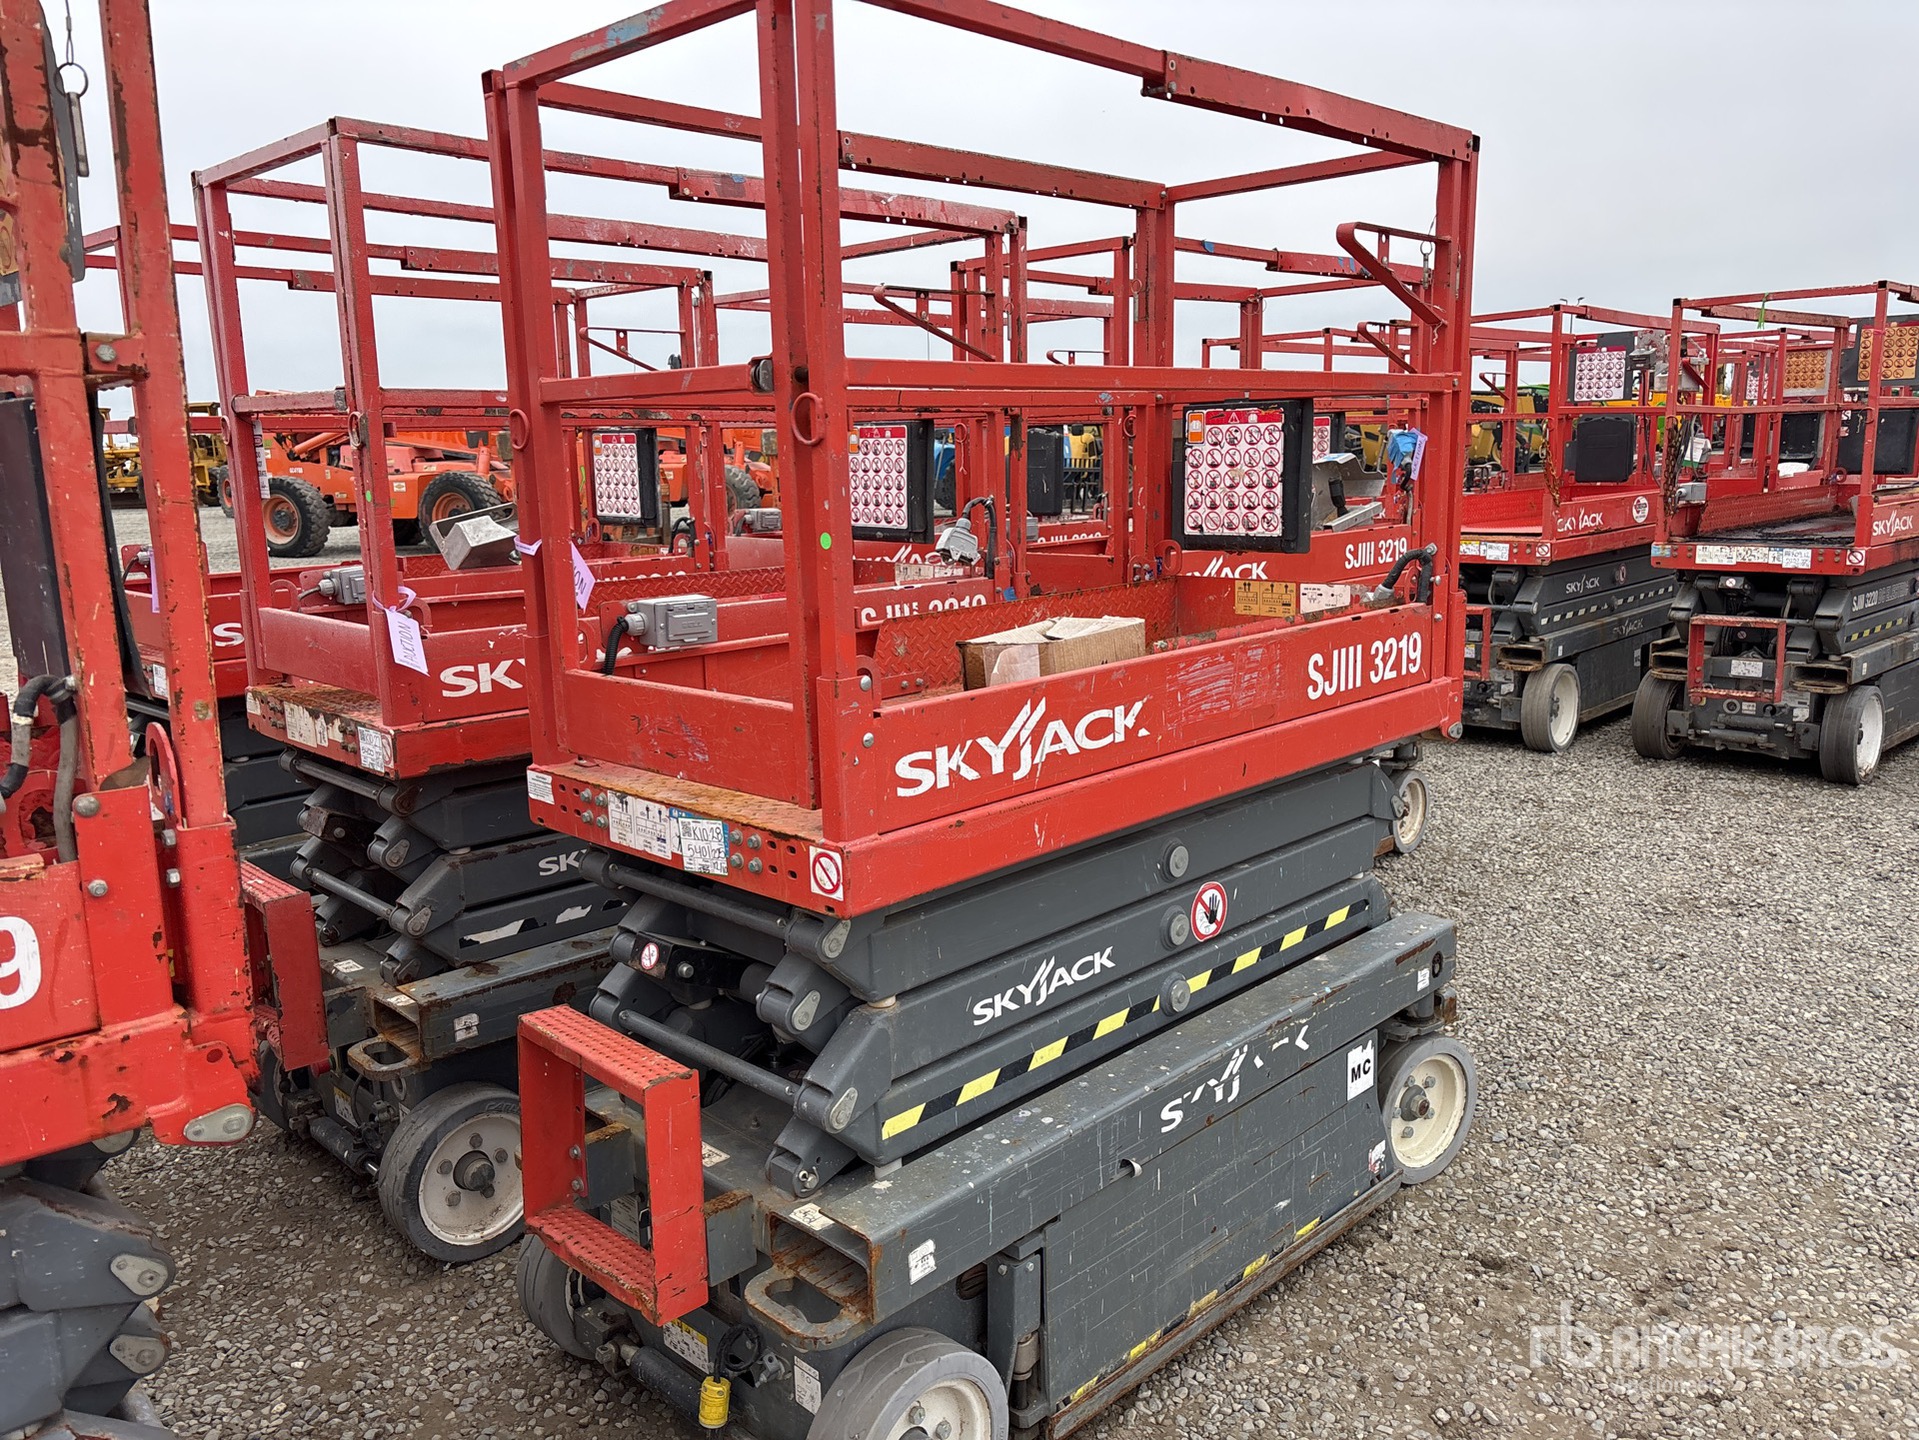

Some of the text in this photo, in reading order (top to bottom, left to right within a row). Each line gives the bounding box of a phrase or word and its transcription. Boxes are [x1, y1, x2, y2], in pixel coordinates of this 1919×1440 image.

[1872, 510, 1914, 537] SKYJACK
[1377, 536, 1407, 564] 3219
[1369, 631, 1422, 684] 3219
[896, 696, 1150, 797] SKYJACK
[973, 946, 1116, 1026] SKYJACK
[1351, 1059, 1372, 1083] MC
